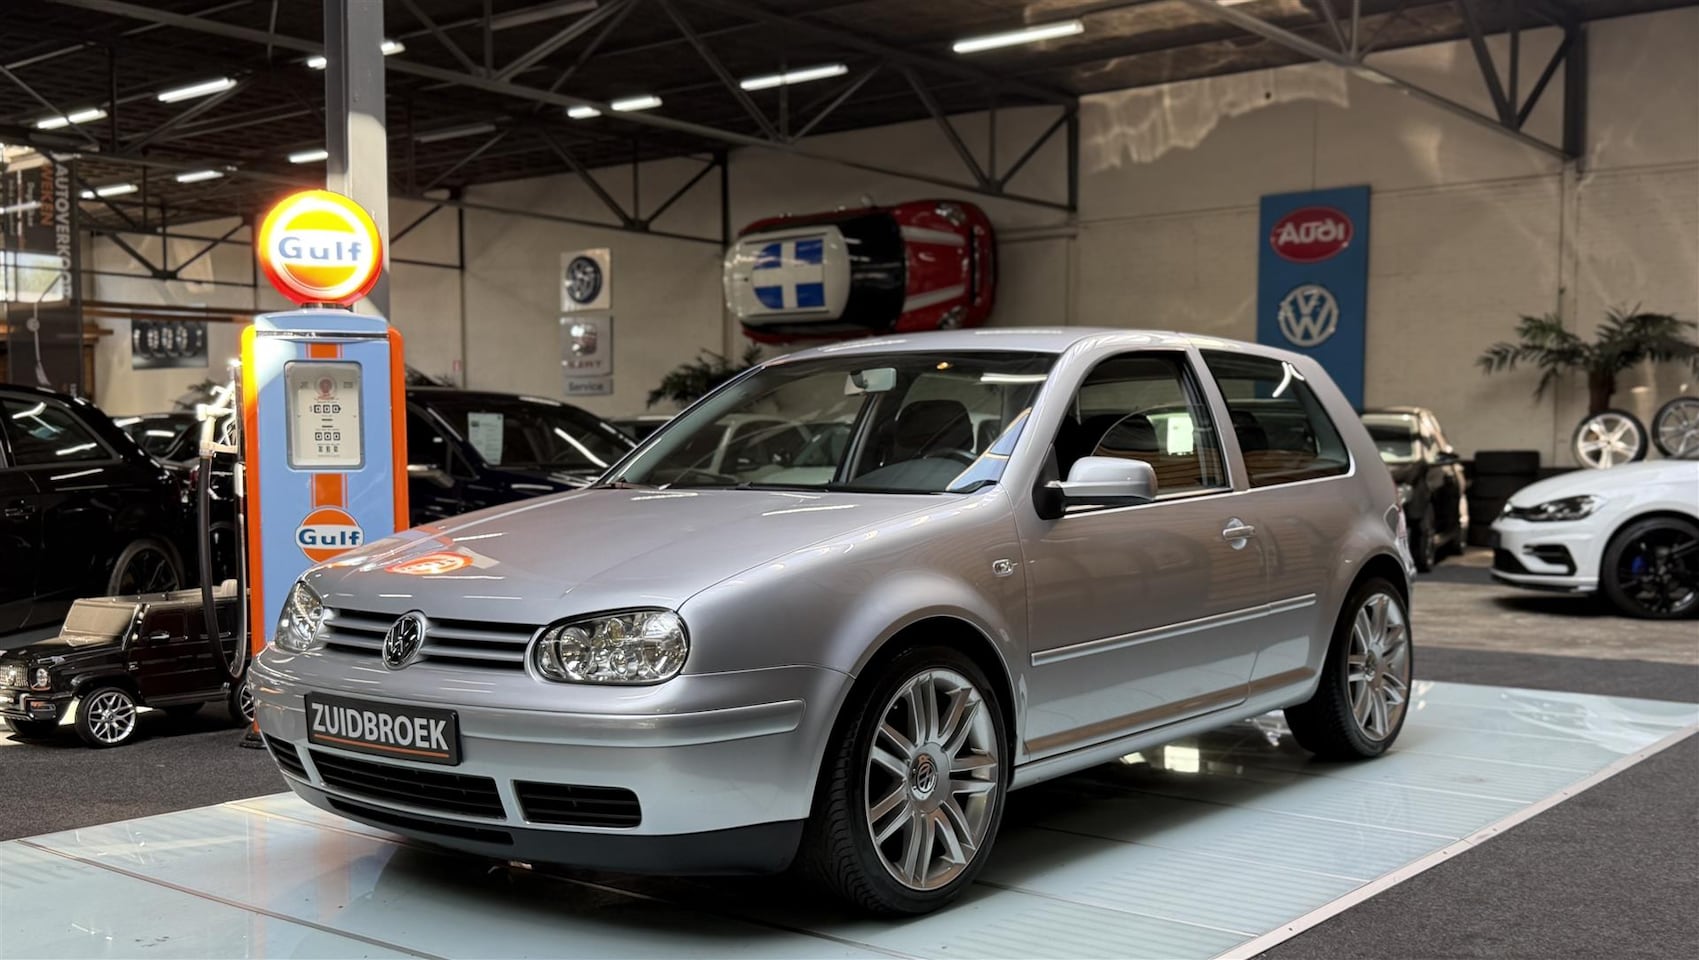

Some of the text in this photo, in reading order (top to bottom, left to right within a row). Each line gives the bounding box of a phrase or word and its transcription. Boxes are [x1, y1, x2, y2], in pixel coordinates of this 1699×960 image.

[278, 236, 363, 263] Gulf
[568, 380, 604, 392] Service
[298, 528, 361, 546] Gulf
[311, 702, 449, 751] ZUIDBROEK
